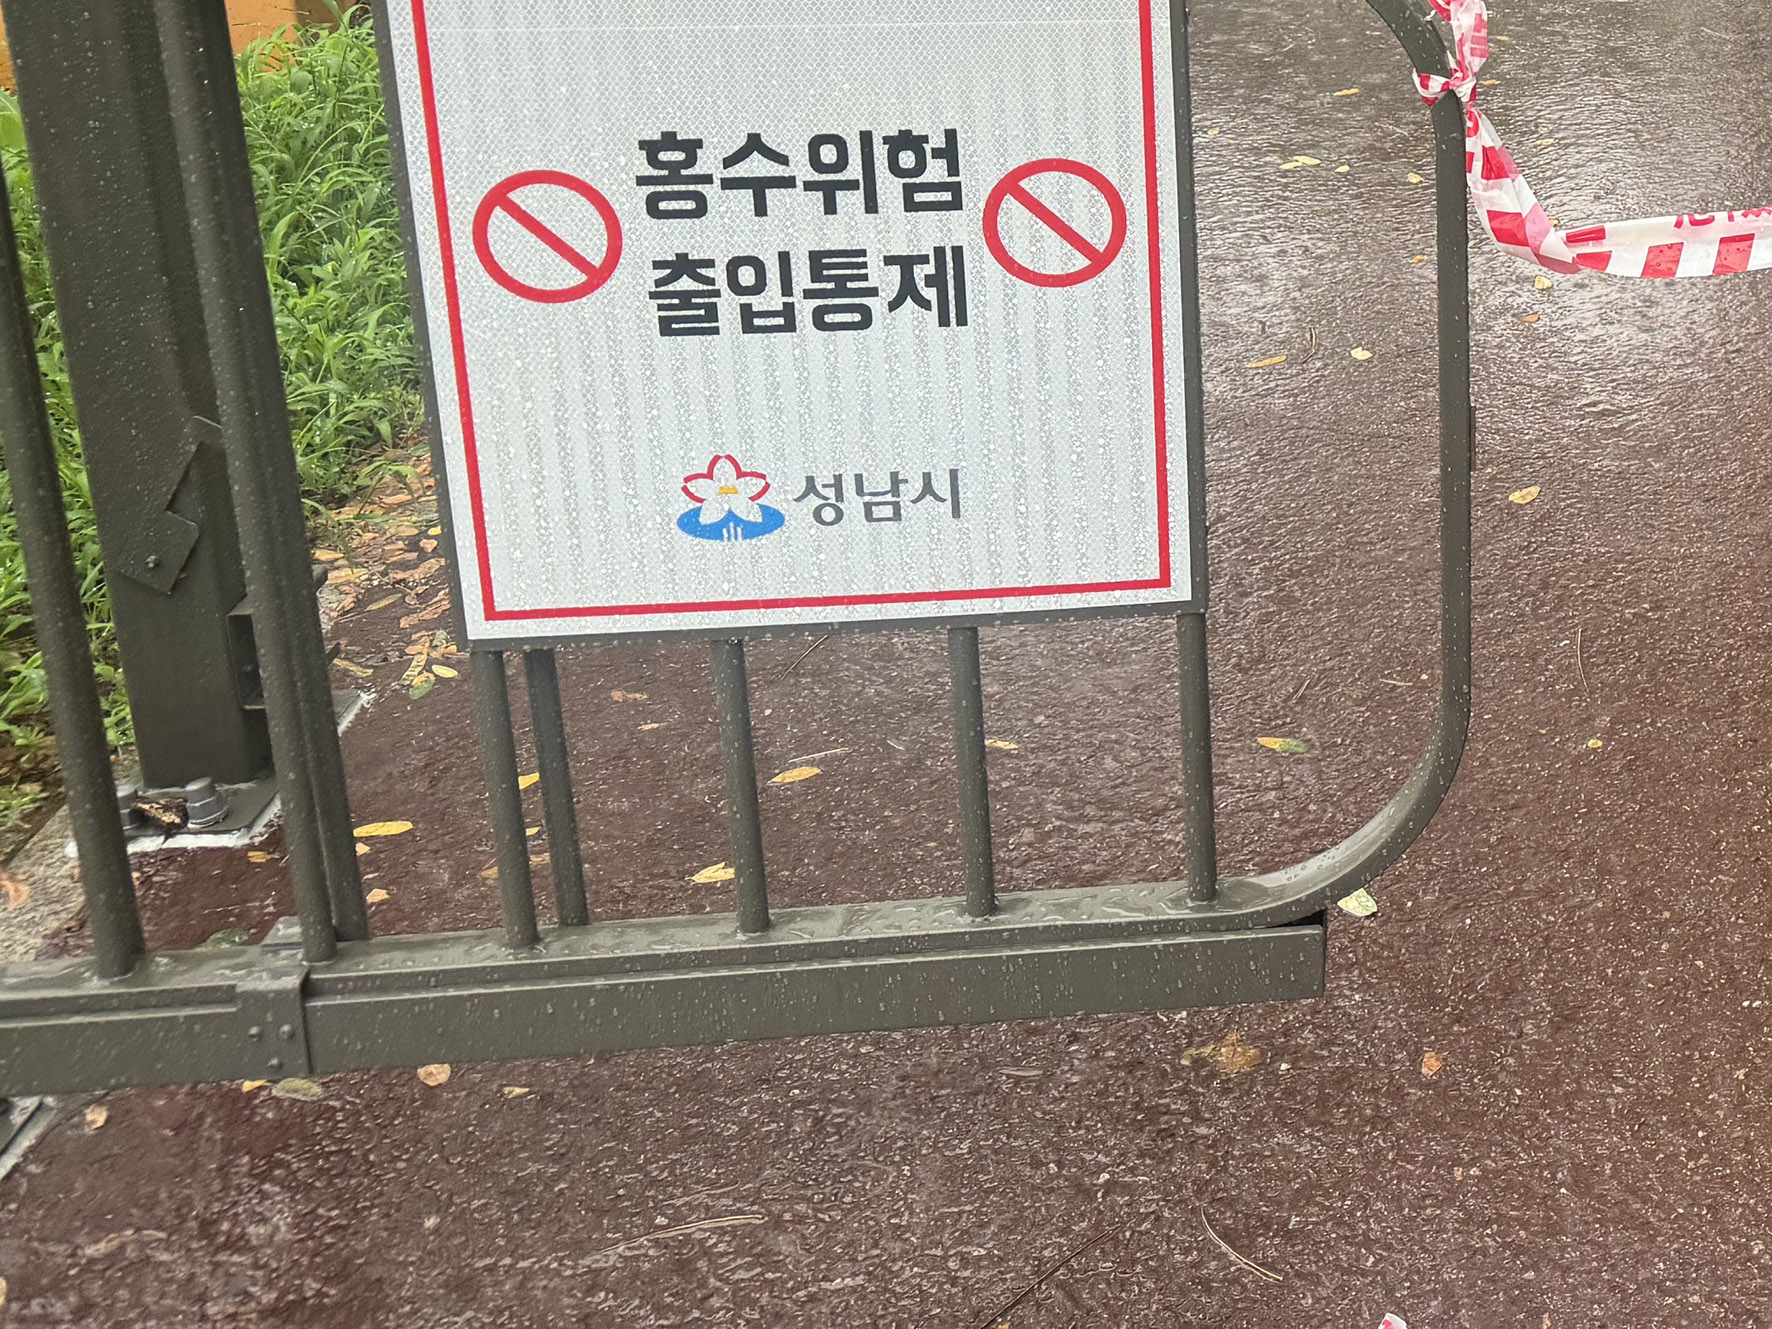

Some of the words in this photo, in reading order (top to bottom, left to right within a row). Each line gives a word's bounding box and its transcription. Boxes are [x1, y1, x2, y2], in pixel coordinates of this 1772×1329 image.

[636, 129, 963, 220] 홍수위험
[647, 245, 968, 337] 출입통제
[792, 468, 961, 527] 성남시
